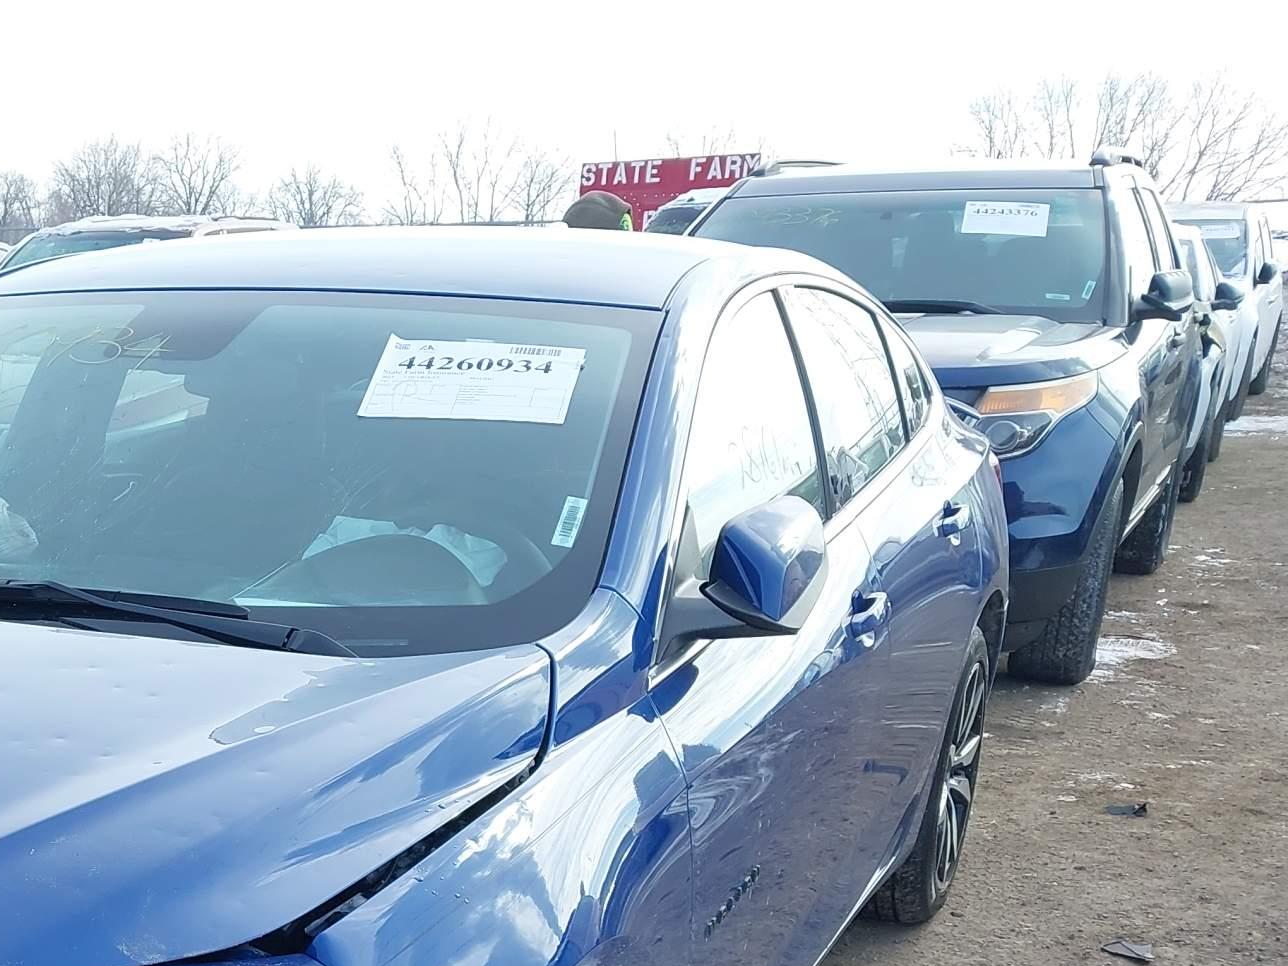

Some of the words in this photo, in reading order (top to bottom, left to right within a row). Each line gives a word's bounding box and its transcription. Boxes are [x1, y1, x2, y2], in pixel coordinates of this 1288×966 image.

[581, 160, 662, 187] STATE
[688, 154, 761, 181] FARM
[973, 207, 1038, 217] 44243376
[398, 356, 553, 374] 44260934
